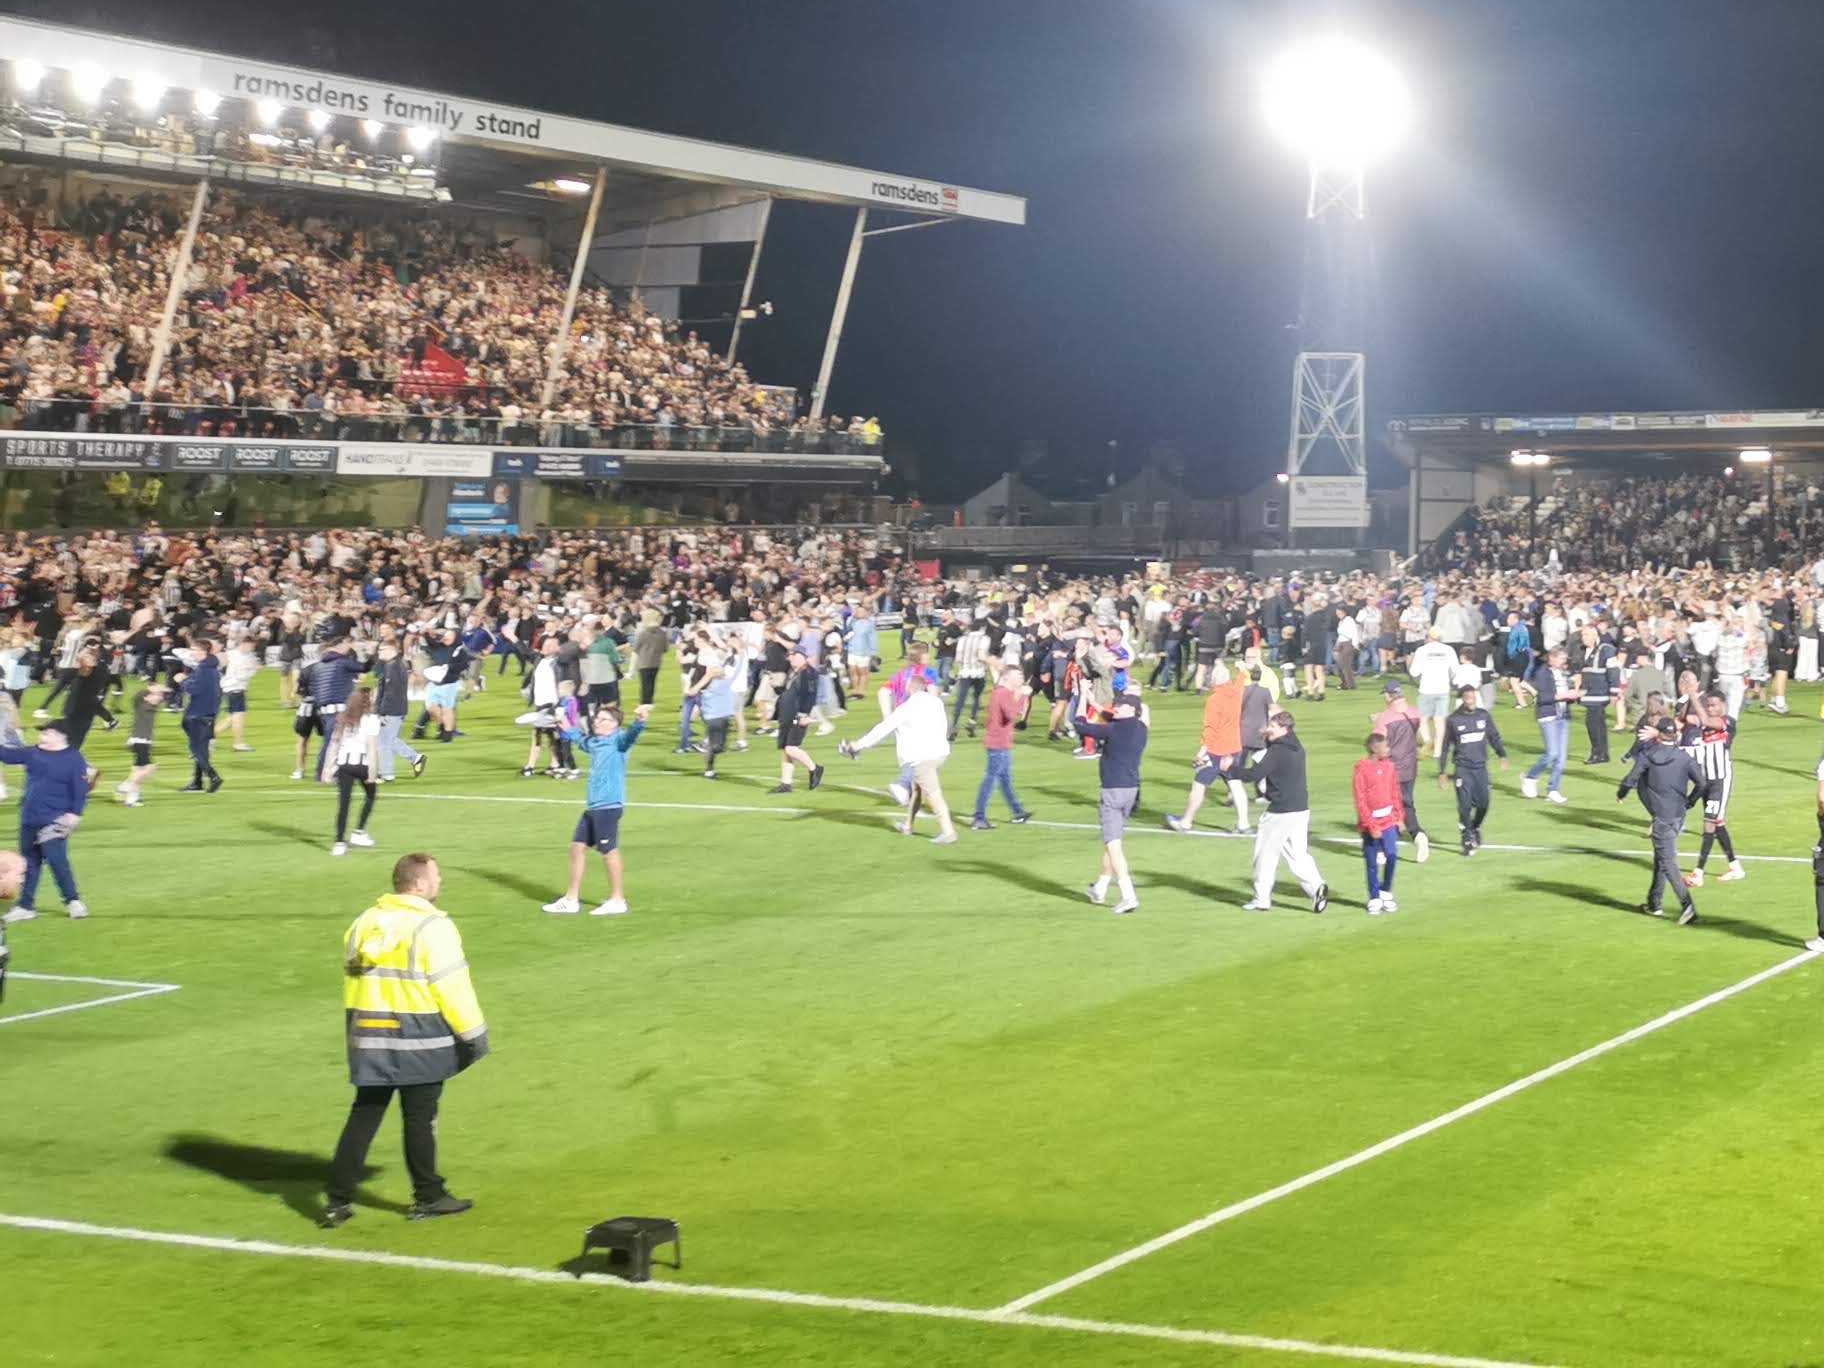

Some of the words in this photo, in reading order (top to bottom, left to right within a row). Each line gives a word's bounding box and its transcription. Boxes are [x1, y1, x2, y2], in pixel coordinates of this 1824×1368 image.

[234, 72, 369, 112] ramsdens
[384, 93, 464, 130] family
[476, 113, 541, 139] stand
[871, 181, 939, 205] ramsdens
[6, 439, 68, 456] SPORTS
[76, 441, 145, 458] THERAPY
[177, 446, 222, 460] ROOST
[235, 447, 278, 461] ROOST
[289, 449, 330, 462] ROOST
